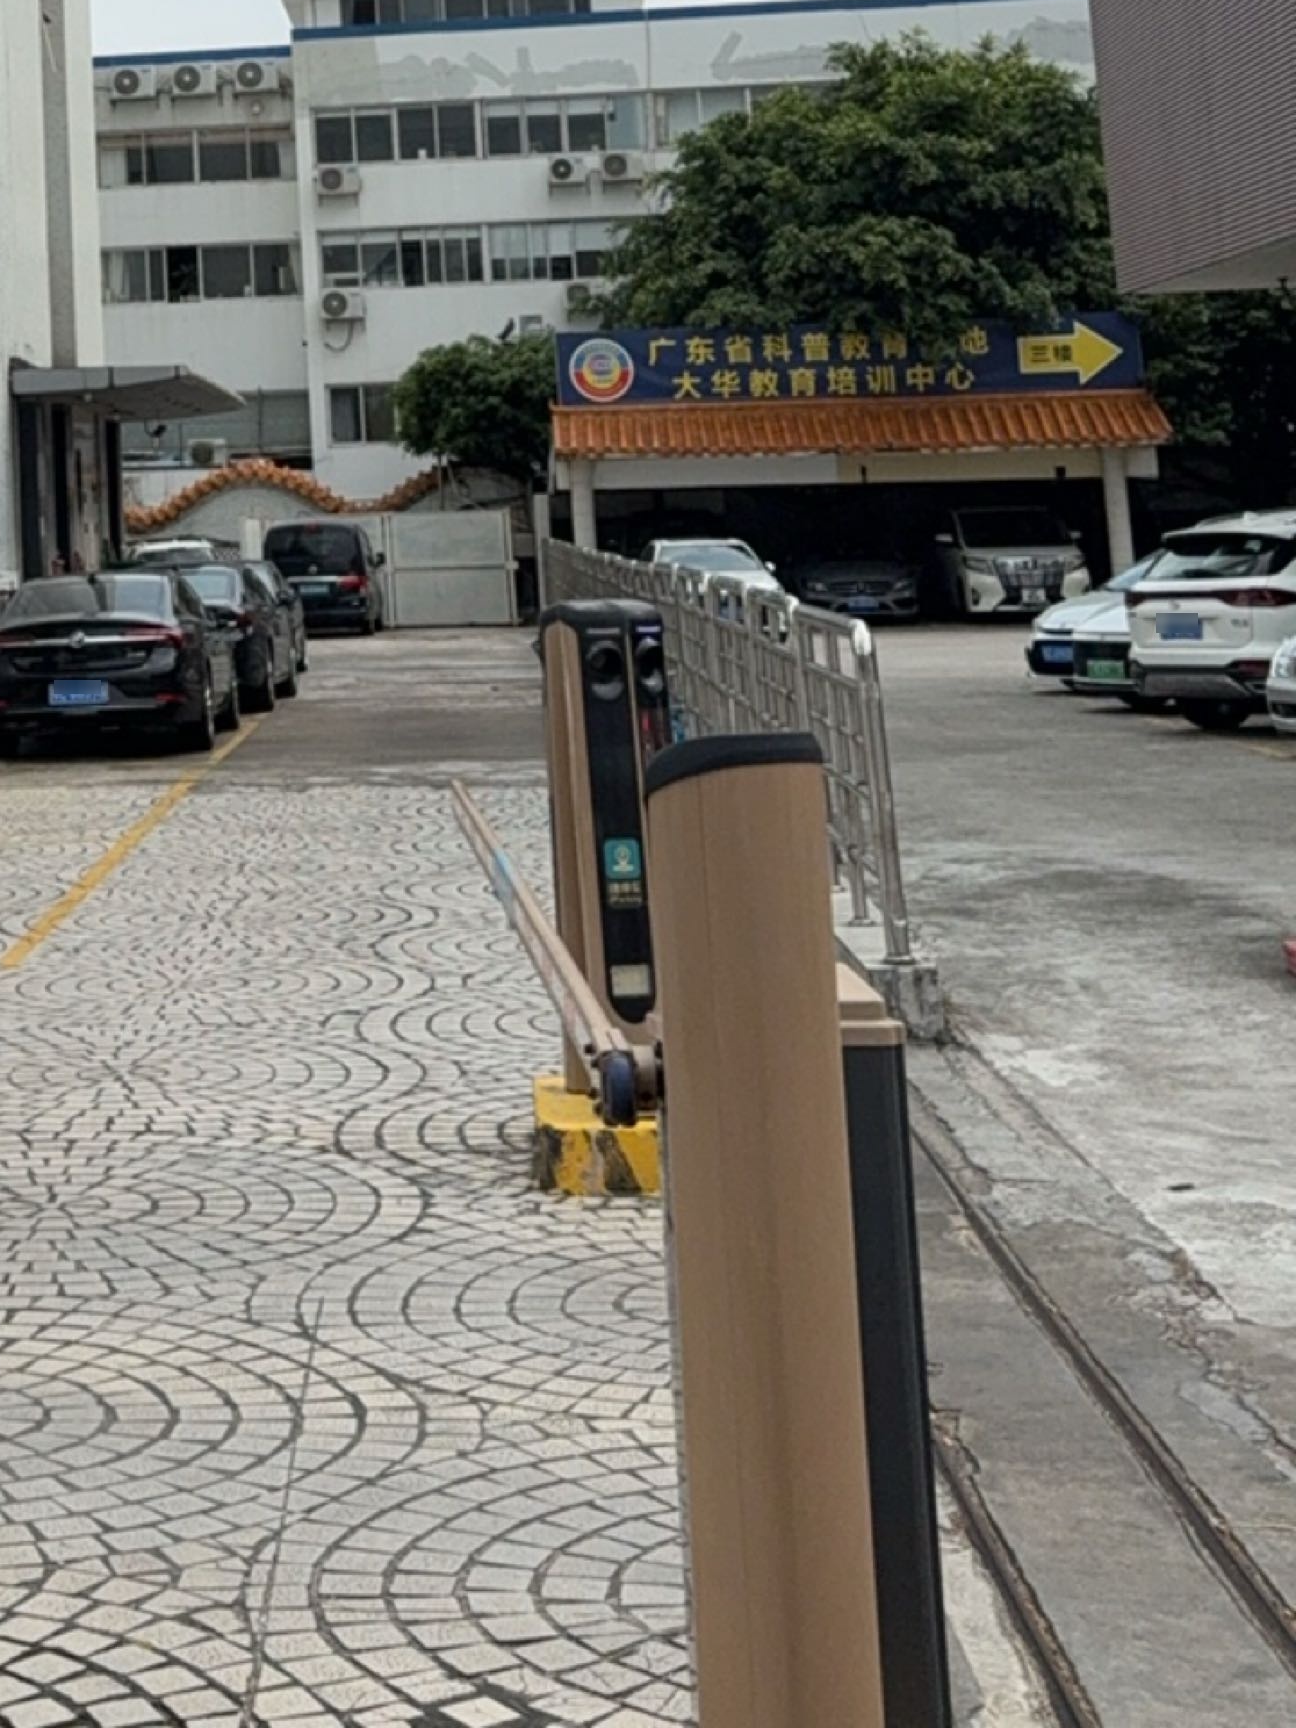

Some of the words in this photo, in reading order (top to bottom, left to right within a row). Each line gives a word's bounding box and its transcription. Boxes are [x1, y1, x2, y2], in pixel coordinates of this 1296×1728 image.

[647, 328, 990, 367] 广东省科普教育地
[672, 362, 975, 400] 大华教育培训中心
